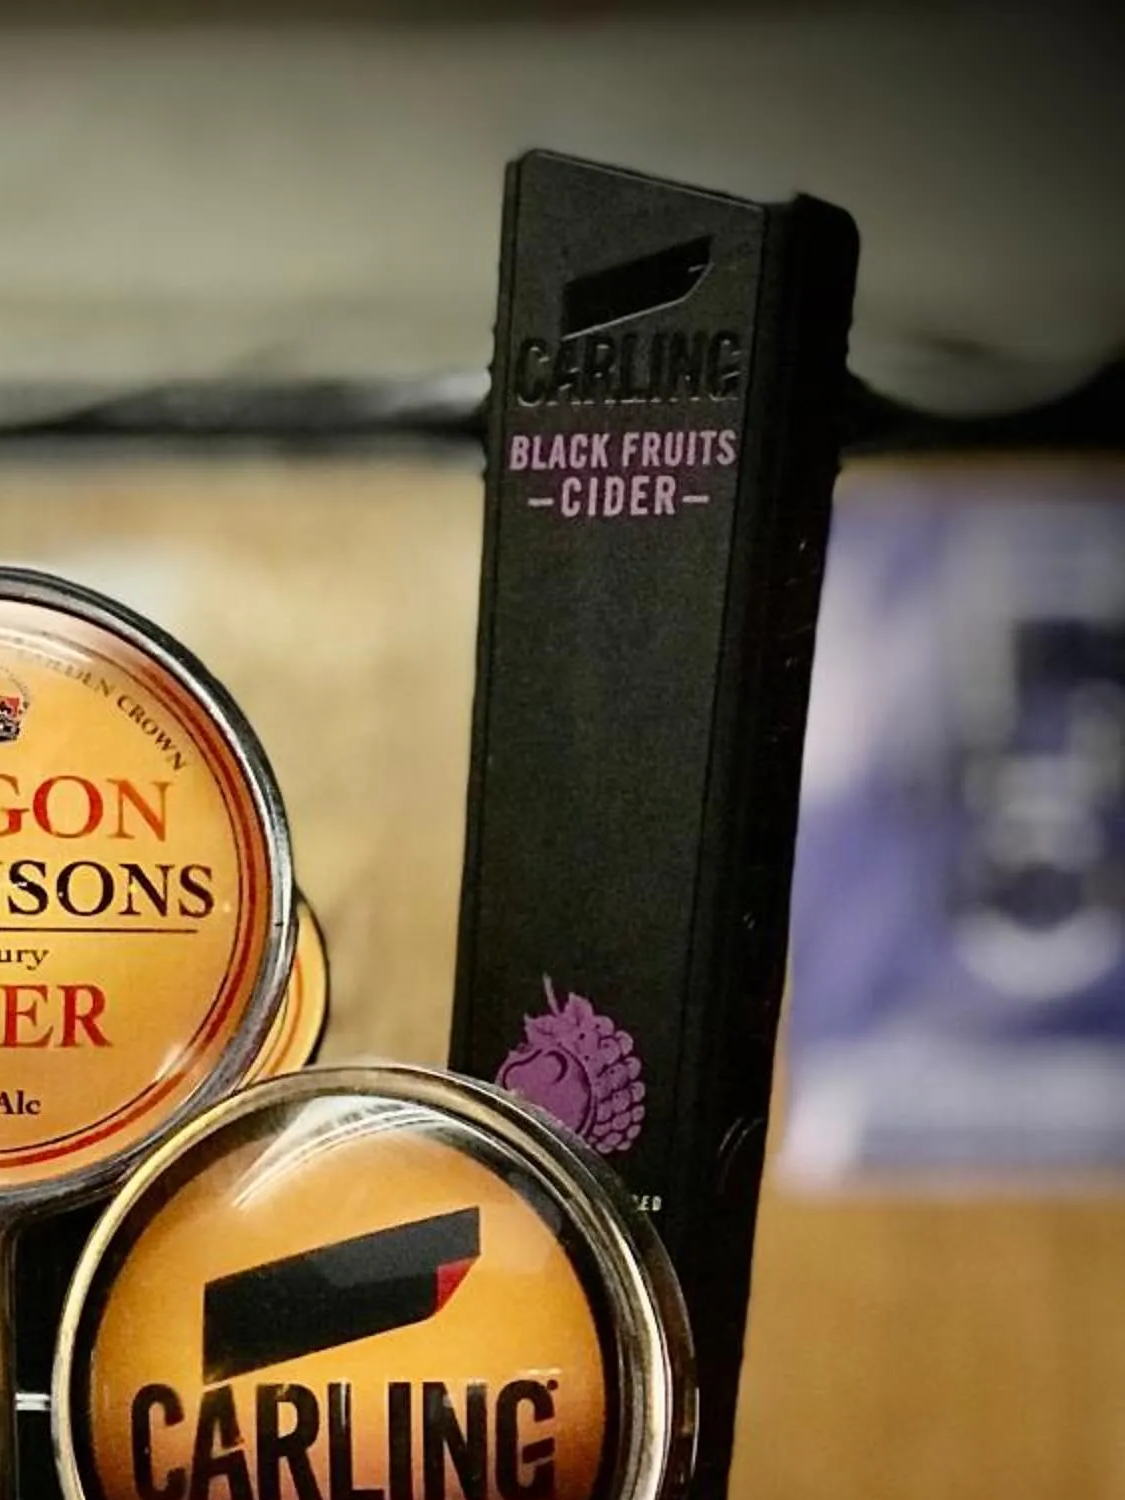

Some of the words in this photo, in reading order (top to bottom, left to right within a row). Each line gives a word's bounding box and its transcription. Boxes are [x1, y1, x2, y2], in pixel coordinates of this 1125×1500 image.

[517, 330, 741, 405] CARLING
[509, 432, 611, 471] BLACK
[621, 429, 738, 469] FRUITS
[561, 475, 676, 518] CIDER
[116, 695, 187, 771] CROWN
